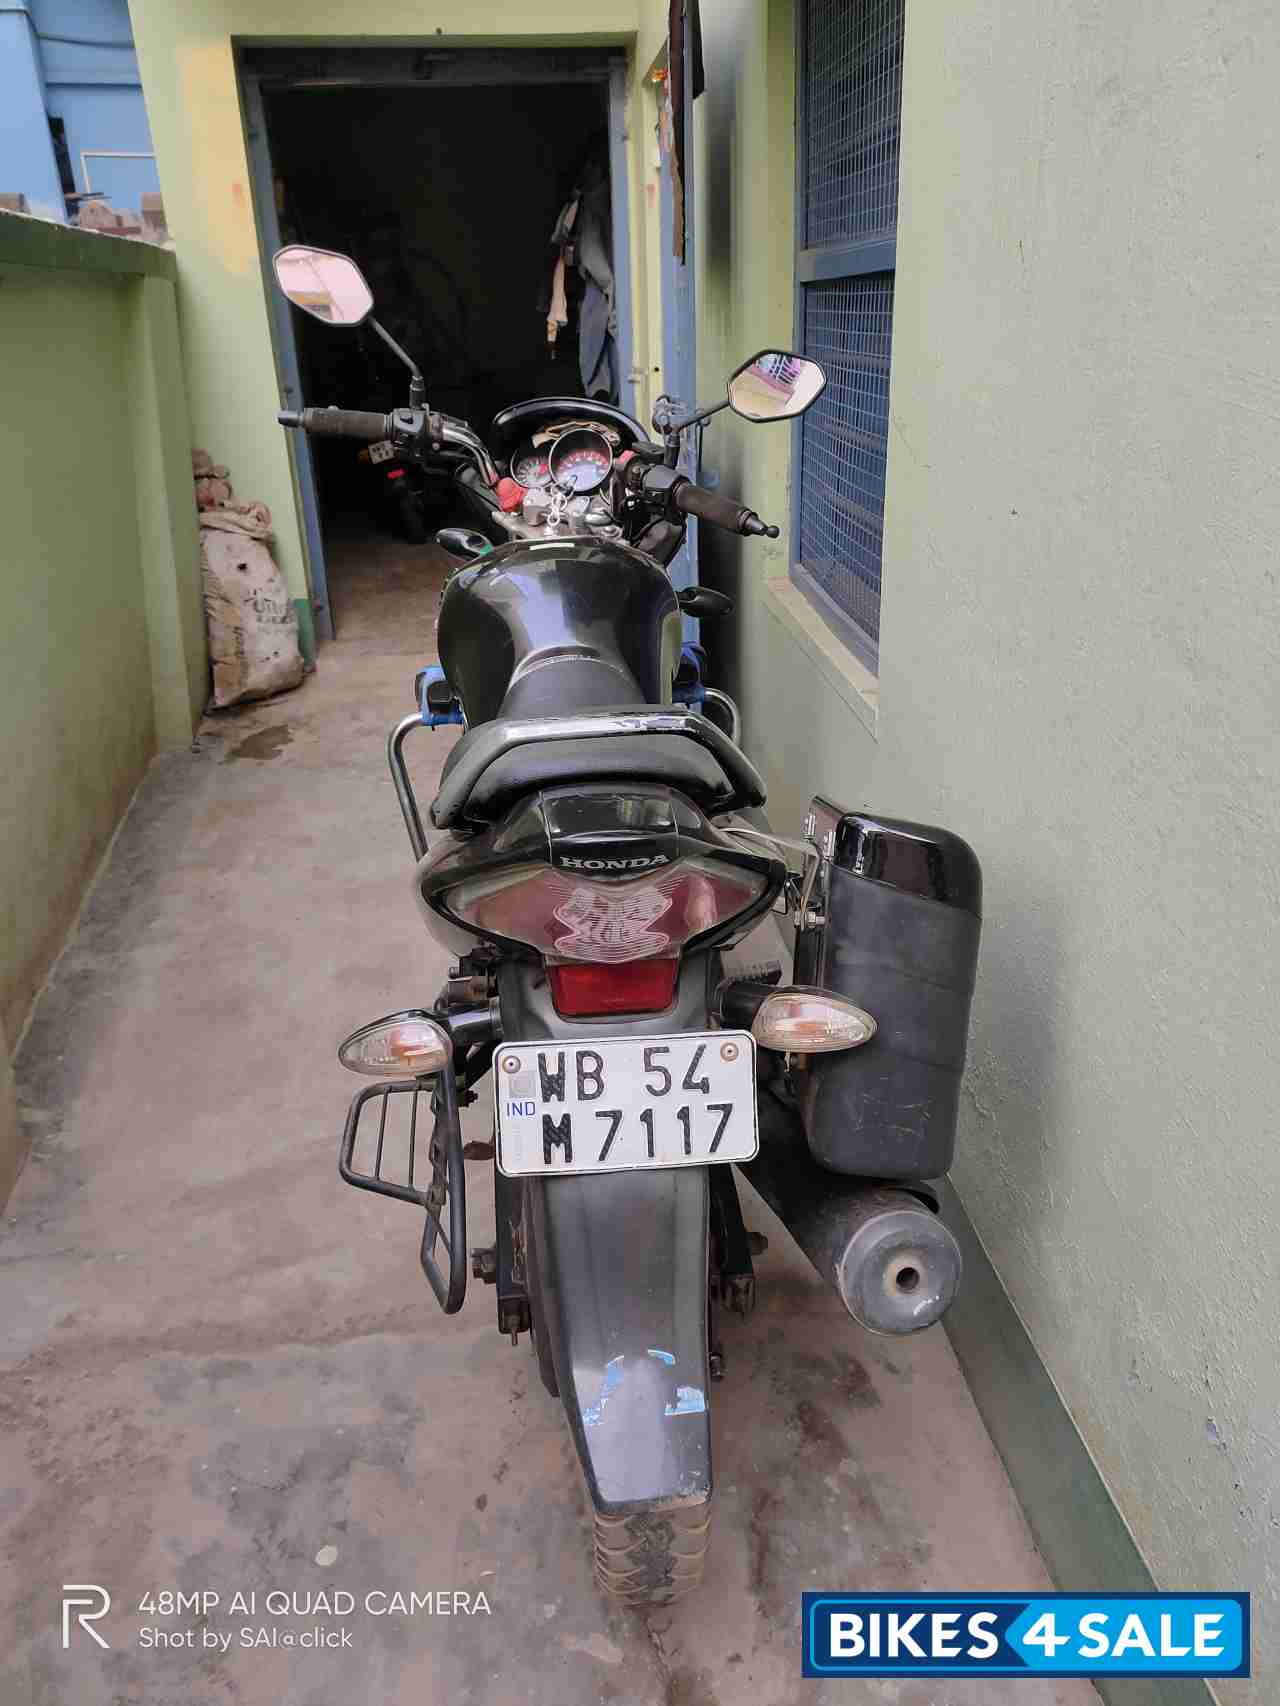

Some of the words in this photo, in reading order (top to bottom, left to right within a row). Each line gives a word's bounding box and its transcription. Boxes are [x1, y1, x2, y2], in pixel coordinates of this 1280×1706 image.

[559, 854, 671, 870] HONDA
[537, 1050, 605, 1103] WB
[643, 1044, 710, 1097] 54
[506, 1101, 536, 1117] IND
